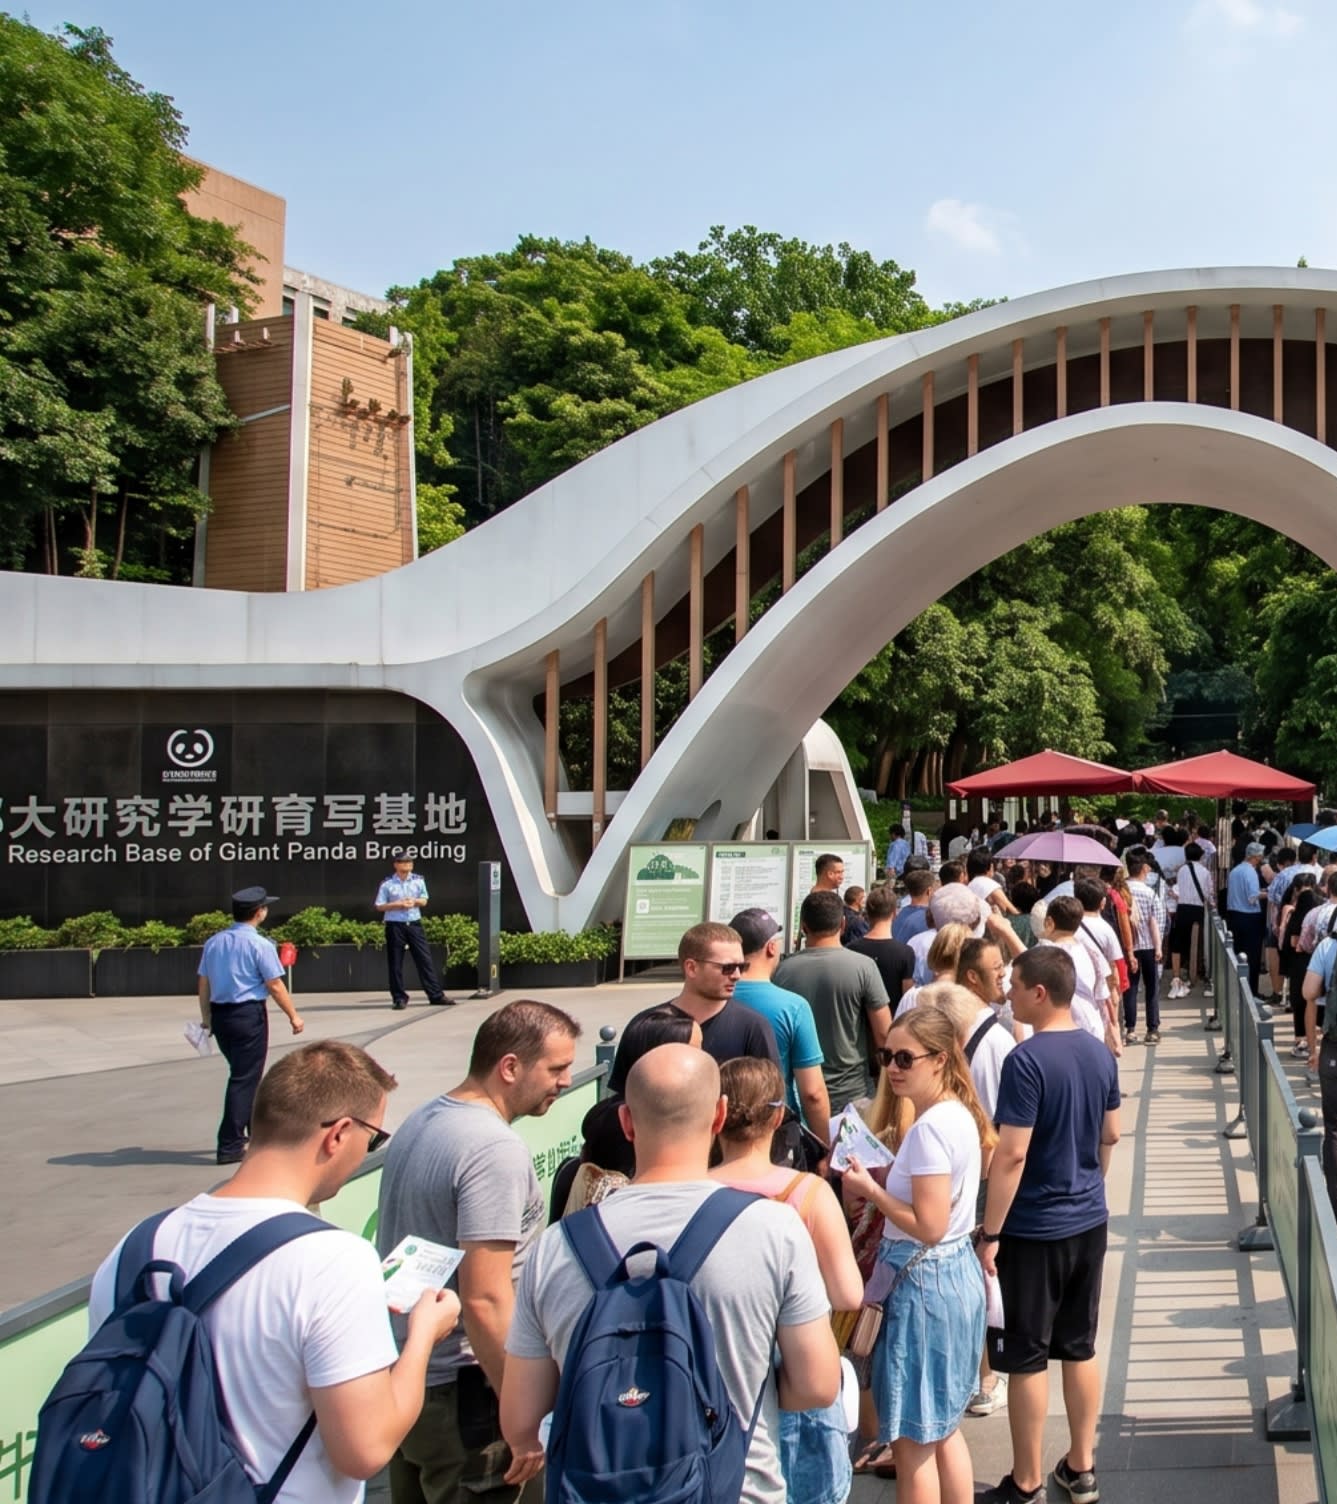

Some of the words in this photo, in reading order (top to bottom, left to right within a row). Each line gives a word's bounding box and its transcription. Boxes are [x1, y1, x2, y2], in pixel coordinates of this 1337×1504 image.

[0, 792, 468, 839] 大研究学研育写基地
[8, 844, 117, 863] Research
[125, 843, 182, 862] Base
[189, 842, 213, 862] of
[219, 842, 280, 861] Giant
[287, 841, 357, 861] Panda
[365, 840, 466, 863] Breeding
